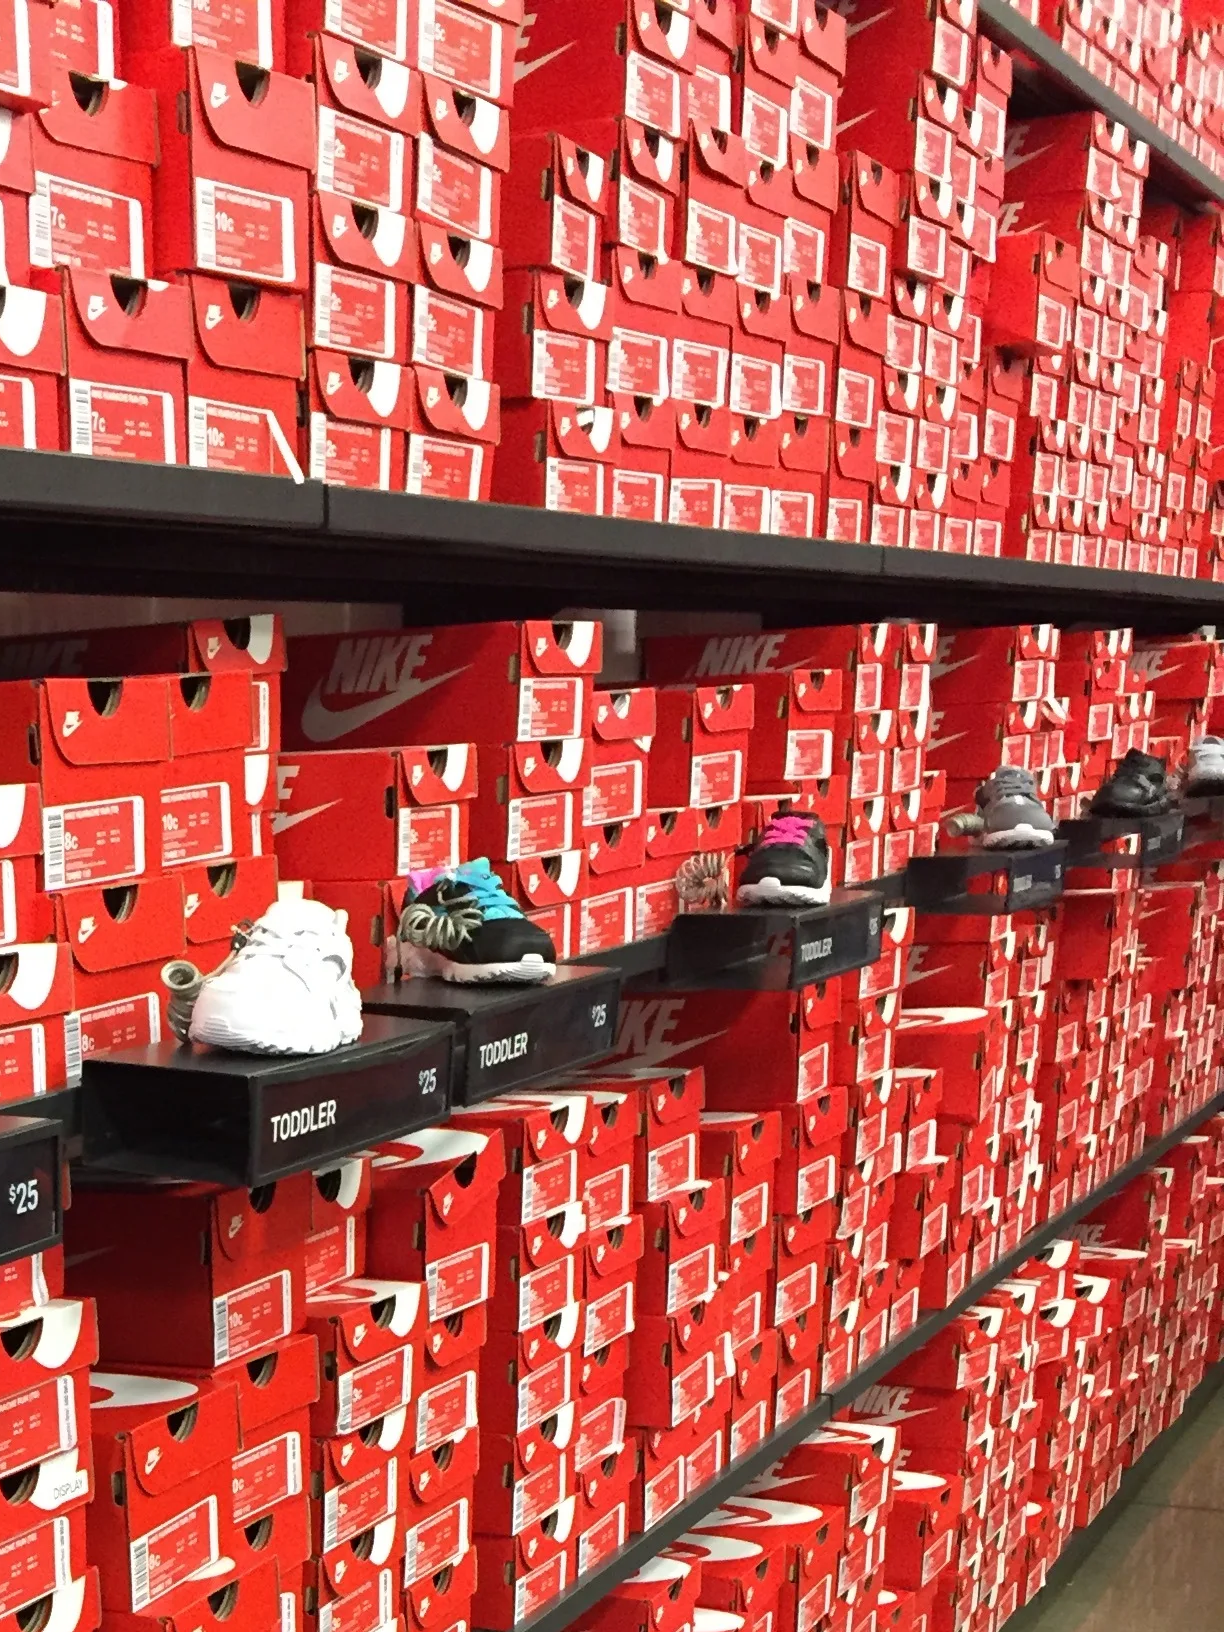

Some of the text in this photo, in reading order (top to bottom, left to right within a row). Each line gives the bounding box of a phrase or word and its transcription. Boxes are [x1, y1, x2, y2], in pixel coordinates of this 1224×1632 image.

[327, 633, 434, 694] NIKE
[700, 634, 785, 677] NIKE
[591, 1003, 607, 1028] $25
[81, 1034, 95, 1052] 8c
[479, 1031, 529, 1069] TODDLER
[418, 1067, 437, 1095] $25
[271, 1099, 337, 1143] TODDLER
[8, 1179, 39, 1215] $25
[53, 1479, 83, 1501] DISPLAY
